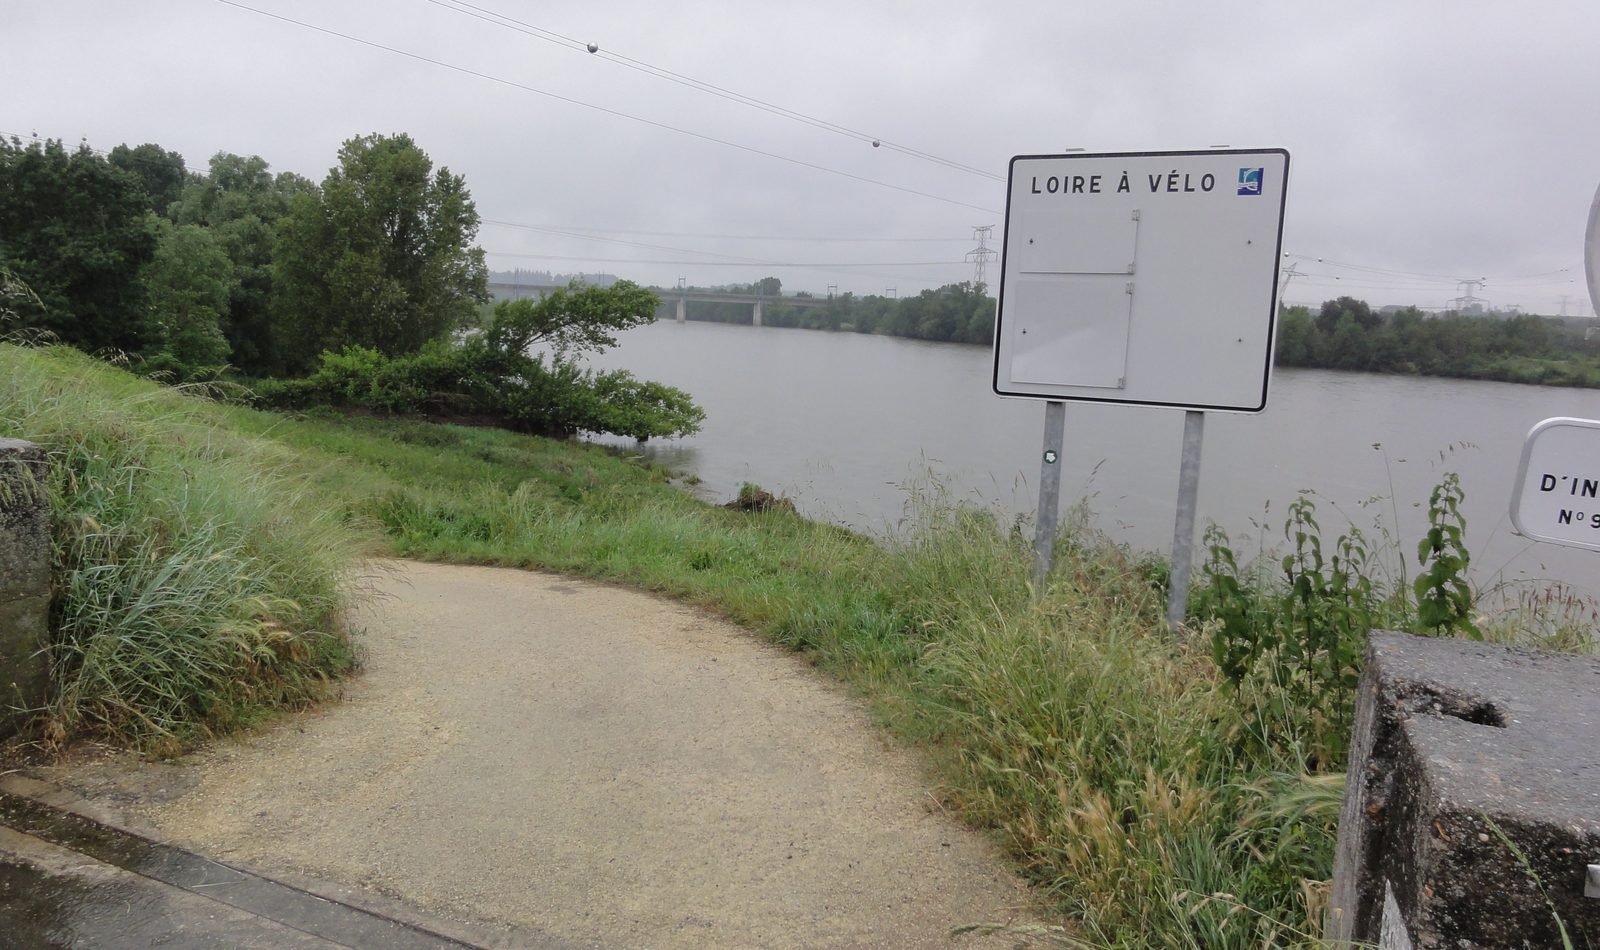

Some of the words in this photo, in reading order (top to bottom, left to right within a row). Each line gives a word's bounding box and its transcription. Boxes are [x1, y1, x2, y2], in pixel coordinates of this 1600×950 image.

[1031, 175, 1102, 194] LOIRE
[1117, 171, 1131, 193] À
[1149, 170, 1216, 193] VÉLO
